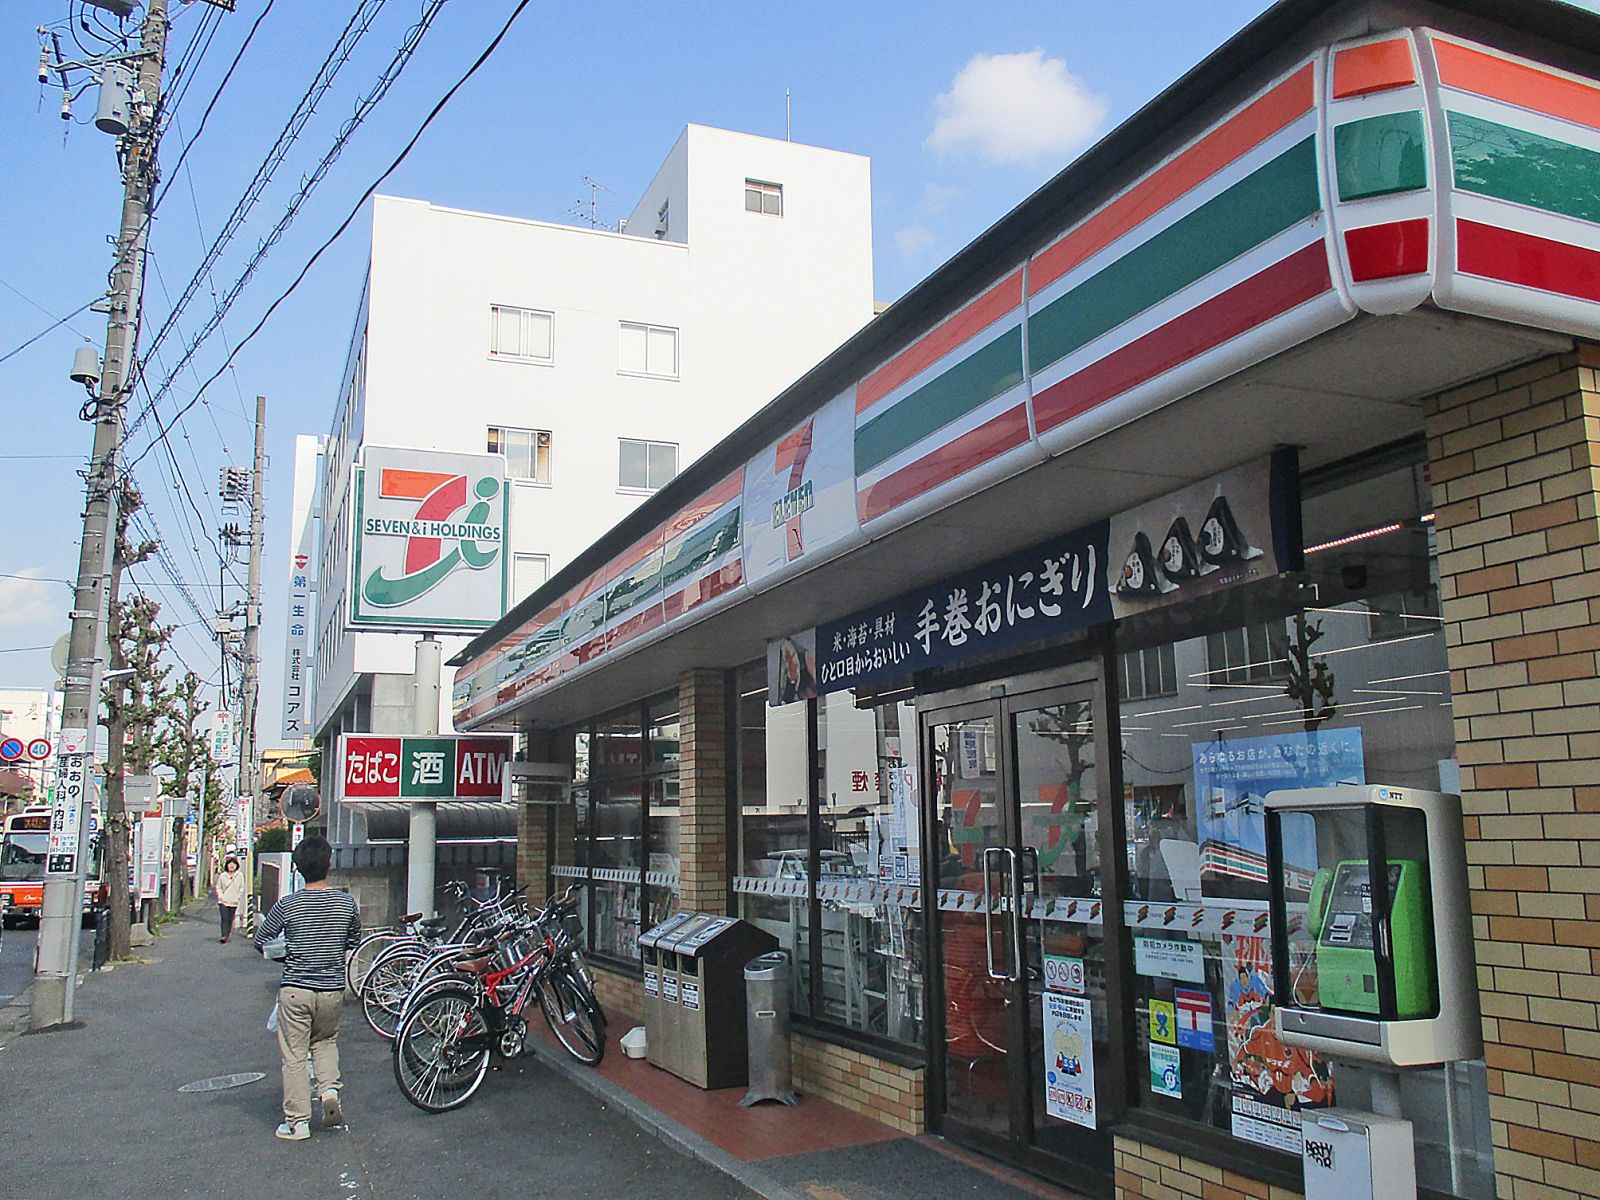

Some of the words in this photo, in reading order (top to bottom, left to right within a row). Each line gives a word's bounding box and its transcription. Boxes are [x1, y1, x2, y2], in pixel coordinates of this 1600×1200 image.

[430, 522, 502, 540] HOLDINGS
[291, 575, 307, 637] 第一生命
[913, 544, 1098, 655] 手巻おにぎり
[832, 611, 896, 653] 米・海苔・具材
[820, 640, 912, 686] ひと口目からおいしい
[32, 743, 47, 756] 40
[68, 757, 82, 799] おおの
[346, 751, 399, 786] たばこ
[411, 751, 447, 786] 酒
[459, 752, 506, 785] ATM
[53, 756, 70, 832] 産婦人科・内科
[1389, 792, 1403, 801] NTT
[1142, 940, 1194, 953] 防犯カメラ作動中
